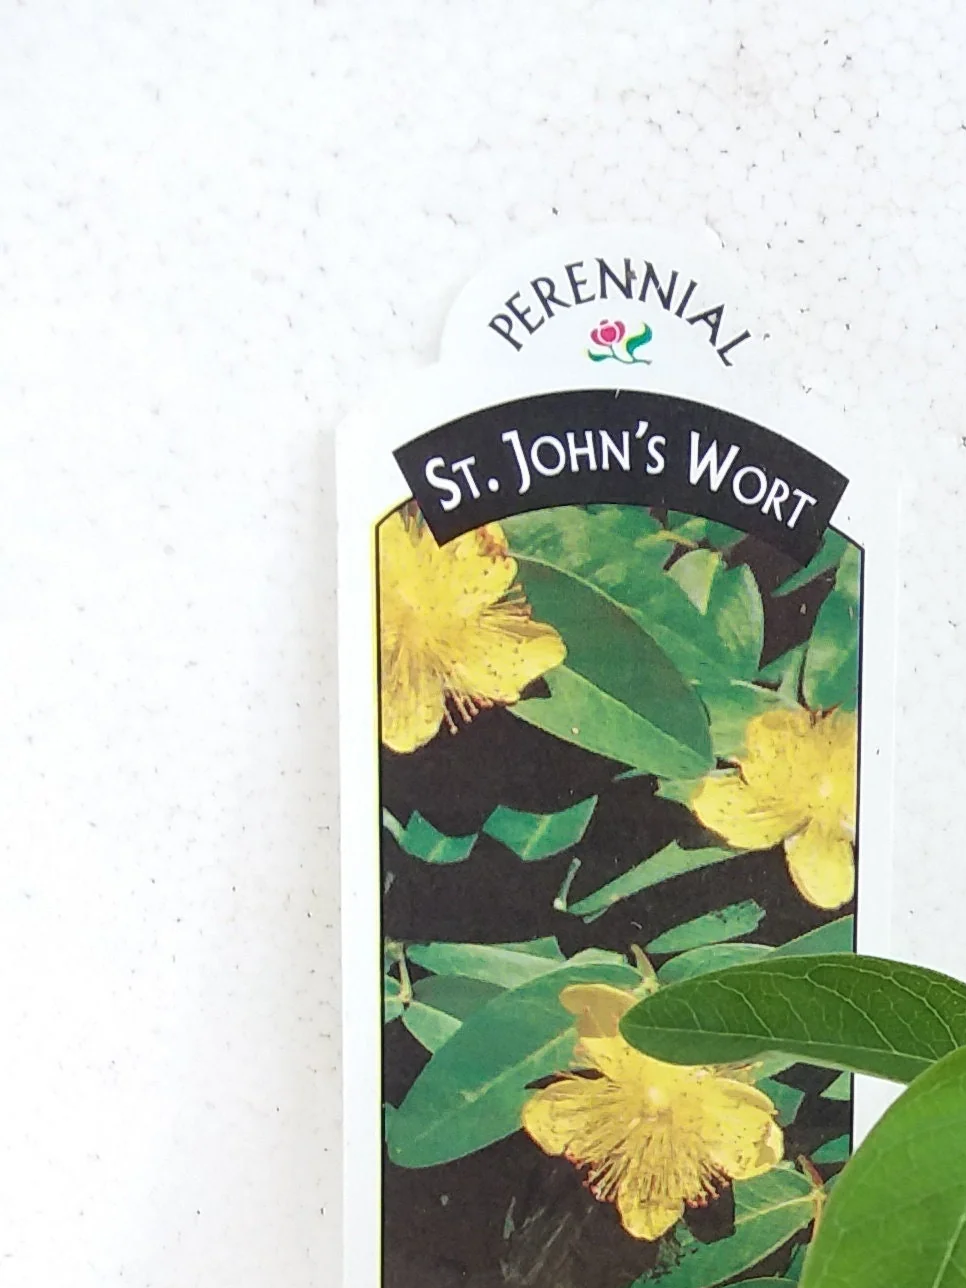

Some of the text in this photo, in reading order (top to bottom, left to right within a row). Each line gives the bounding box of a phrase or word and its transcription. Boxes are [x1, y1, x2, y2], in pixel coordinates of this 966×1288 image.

[488, 257, 752, 367] PERENNIAL
[425, 420, 818, 529] ST. JOHN'S WORT
